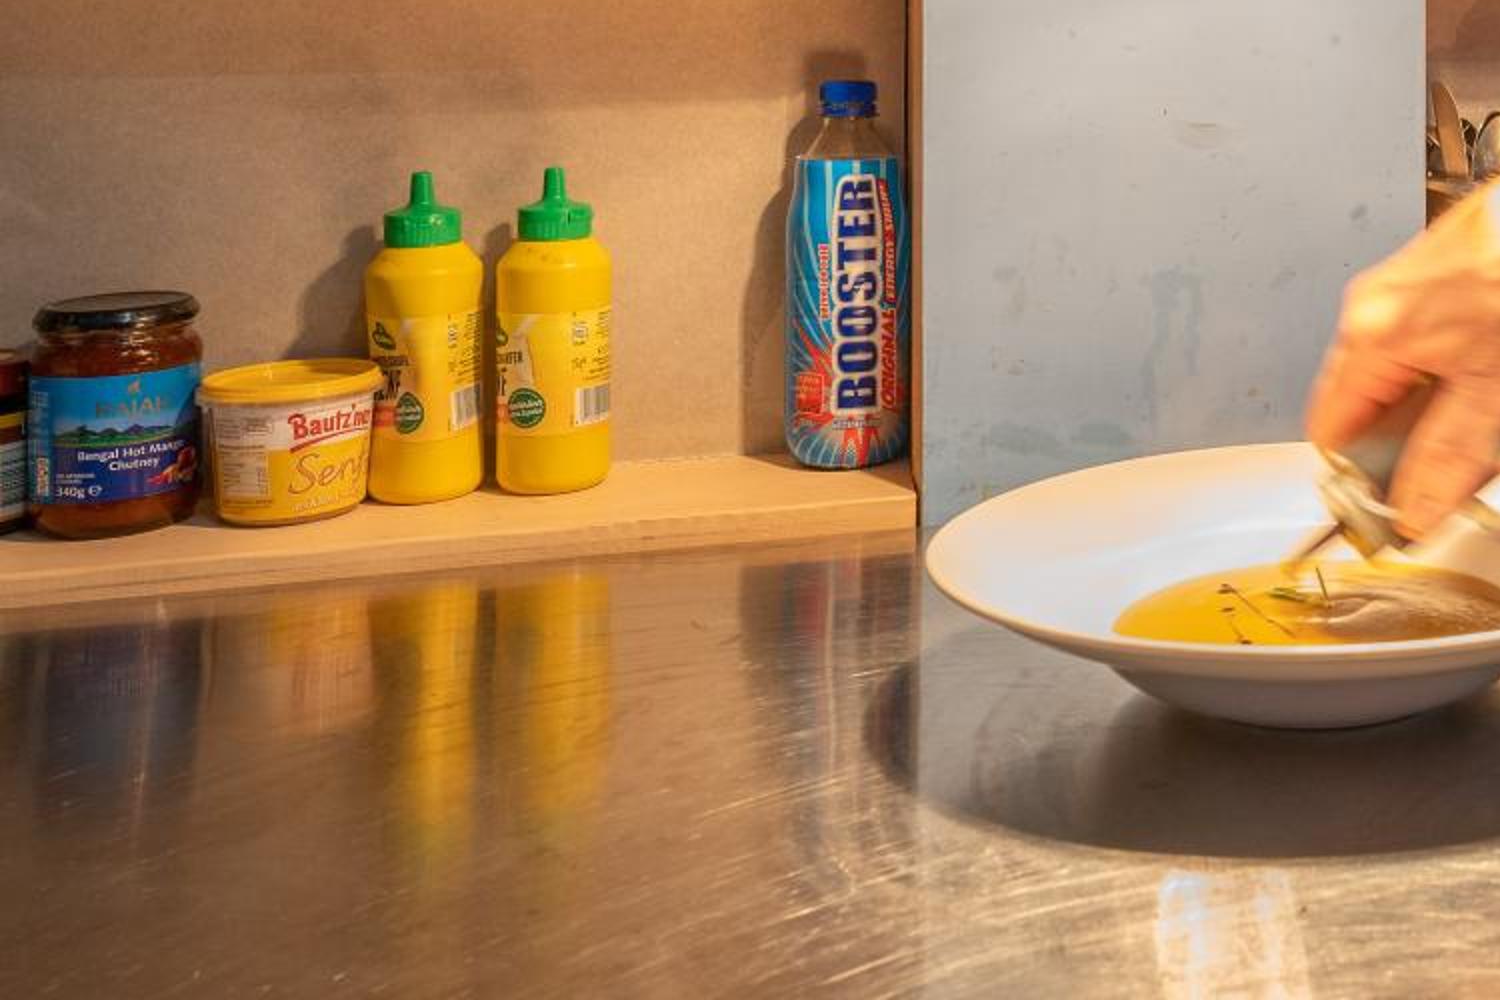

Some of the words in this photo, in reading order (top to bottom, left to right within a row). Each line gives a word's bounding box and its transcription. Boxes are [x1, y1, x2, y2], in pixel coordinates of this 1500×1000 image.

[836, 178, 879, 410] BOOSTER
[881, 309, 898, 410] ORIGINAL
[288, 403, 370, 441] Bautz'ne
[77, 447, 119, 463] Bengal
[123, 445, 146, 458] Hot
[109, 456, 160, 471] Chutney
[56, 486, 86, 499] 340g
